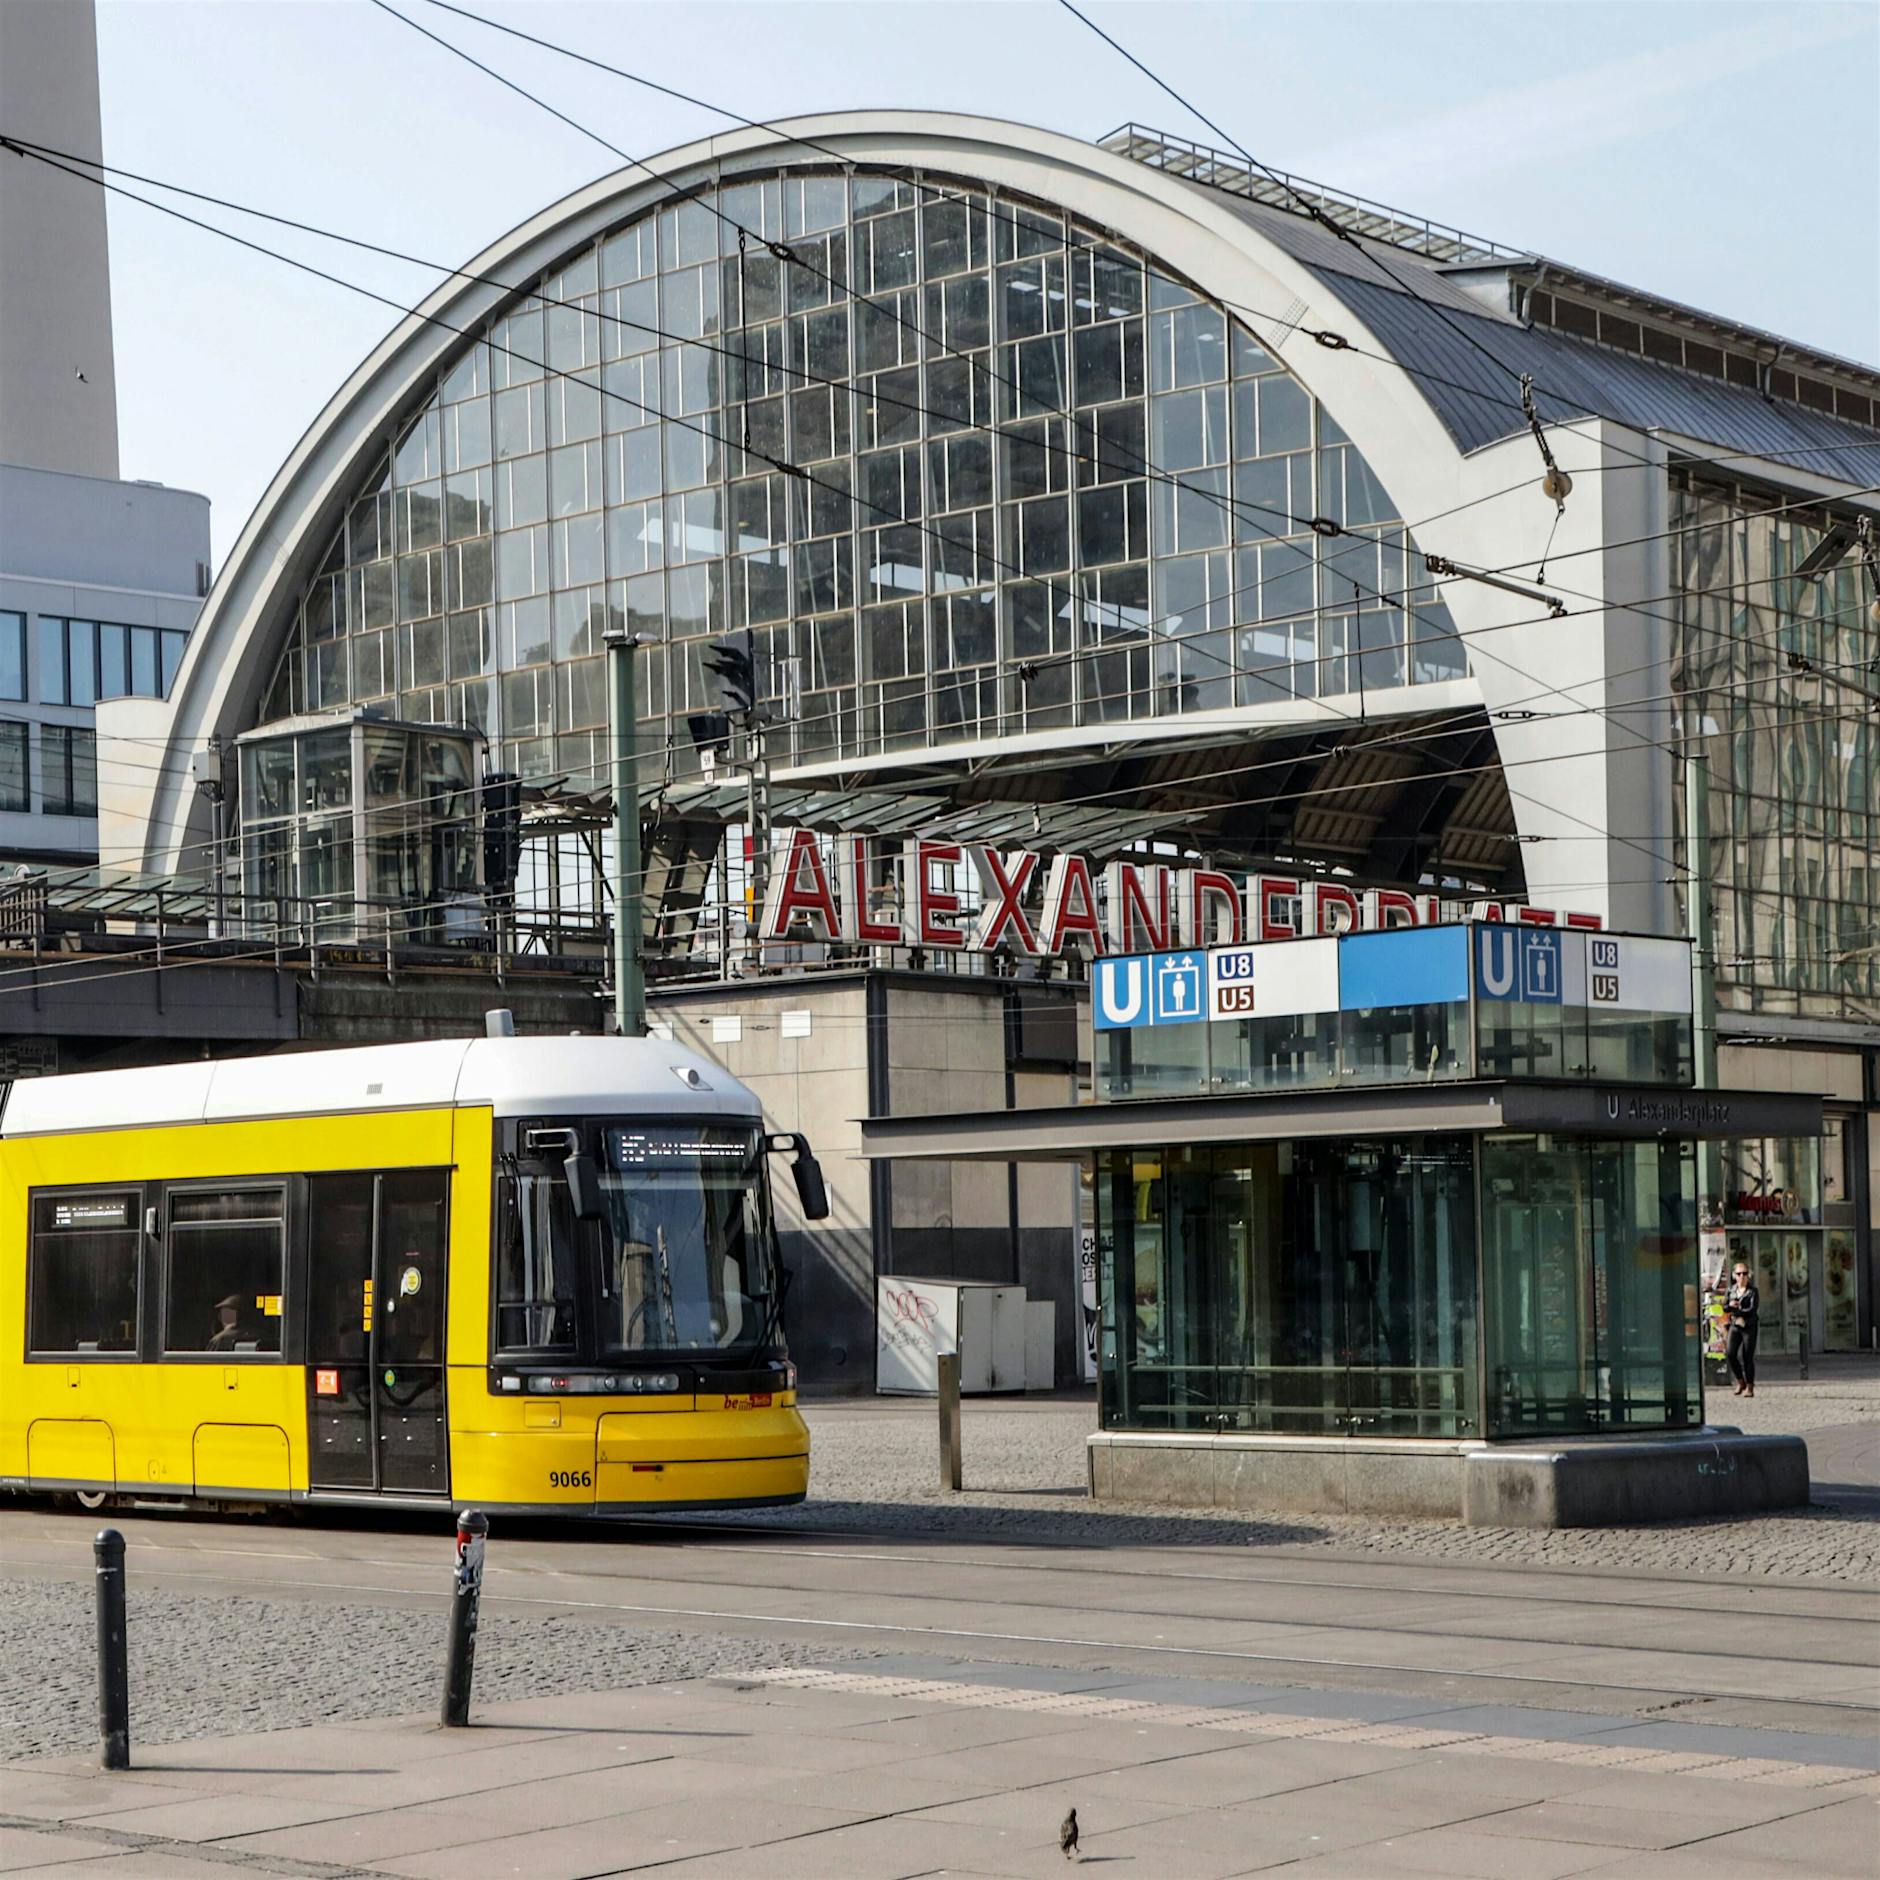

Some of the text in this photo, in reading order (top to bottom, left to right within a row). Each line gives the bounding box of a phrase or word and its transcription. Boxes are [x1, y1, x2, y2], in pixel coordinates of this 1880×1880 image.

[759, 826, 1606, 957] ALEXANDER
[1220, 954, 1251, 978] U8
[1481, 929, 1514, 997] U
[1594, 941, 1617, 966] U8
[1101, 960, 1142, 1024] U
[1221, 987, 1252, 1011] U5
[1594, 976, 1618, 1000] U5
[1607, 1095, 1729, 1127] U Alexanderplatz
[549, 1470, 592, 1488] 9066
